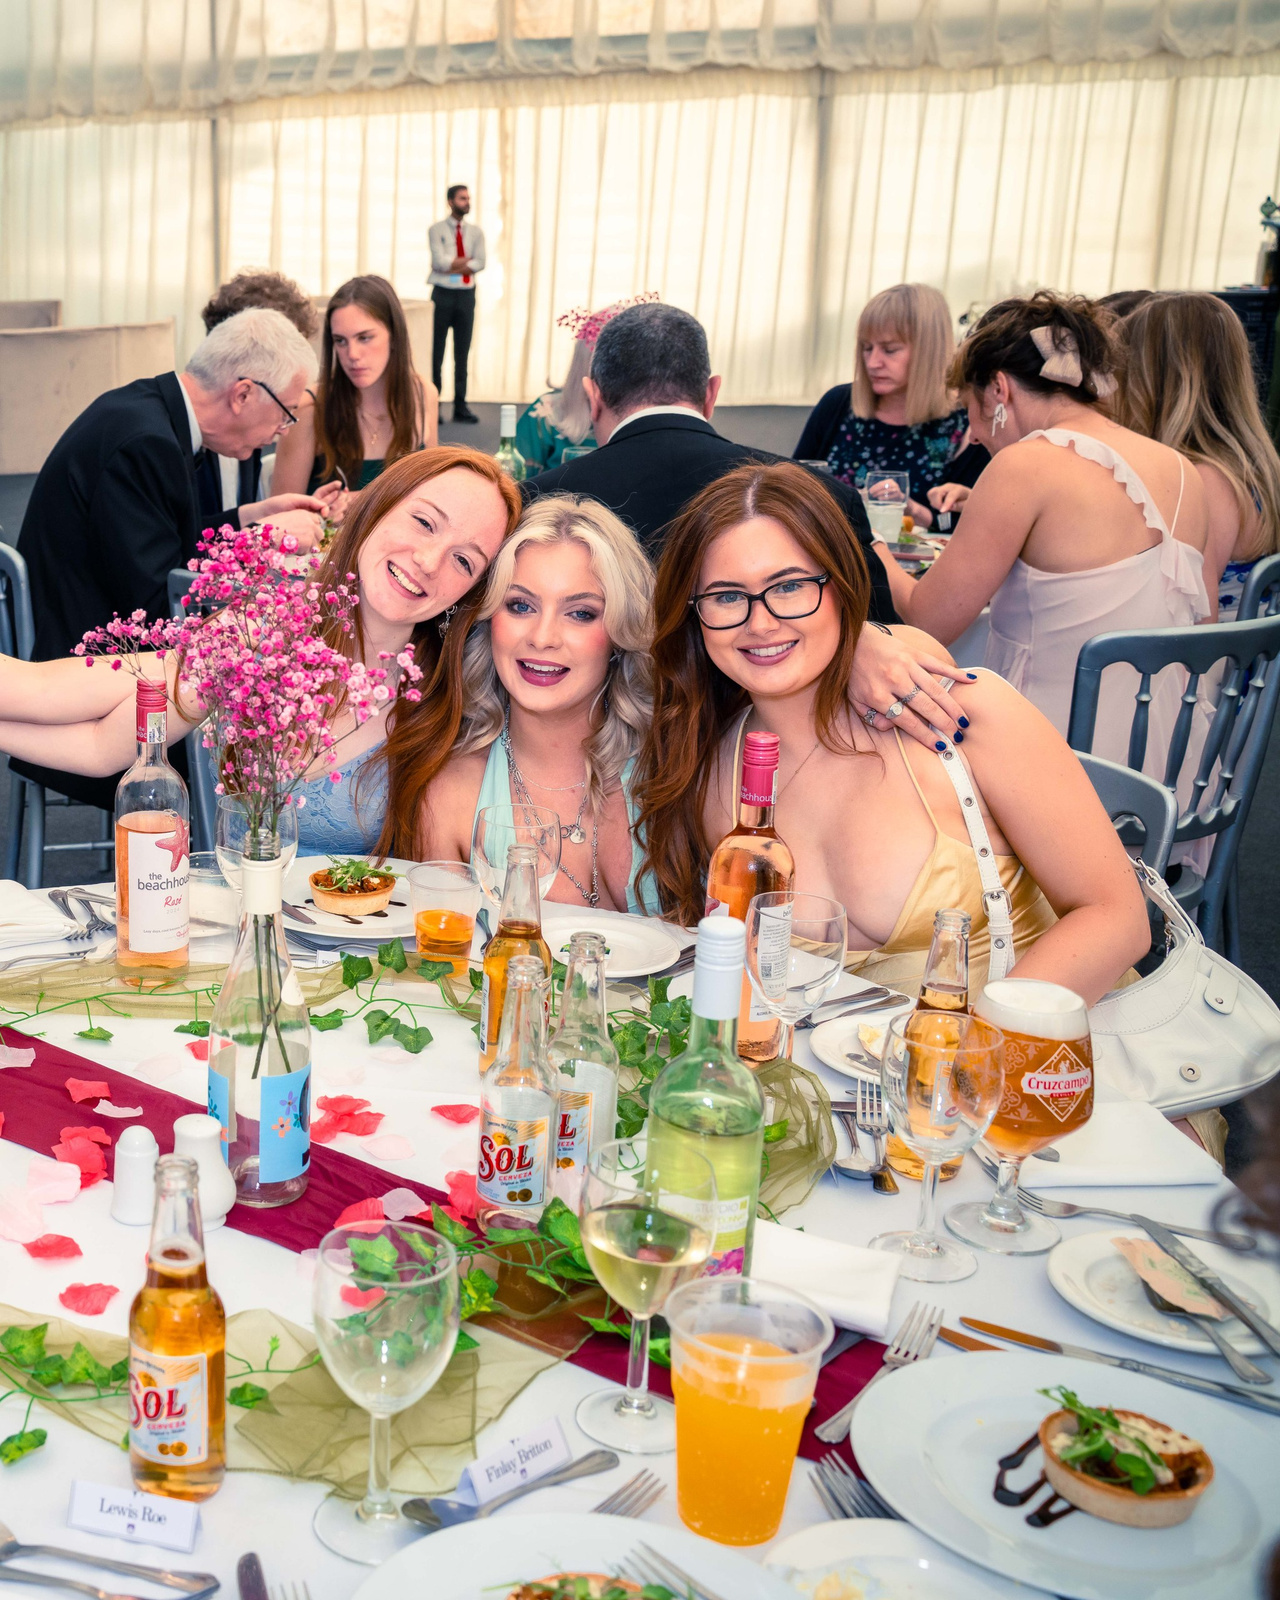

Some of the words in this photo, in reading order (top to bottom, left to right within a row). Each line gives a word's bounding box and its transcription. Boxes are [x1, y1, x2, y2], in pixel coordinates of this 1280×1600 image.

[137, 873, 190, 891] beachhou
[149, 872, 163, 880] the
[163, 894, 183, 907] Rosé
[1028, 1075, 1088, 1090] Cruzcampo
[479, 1135, 534, 1182] SOL
[499, 1171, 532, 1181] CERVEZA
[129, 1372, 186, 1430] SOL
[485, 1458, 517, 1482] Finlay
[517, 1439, 552, 1464] Britton
[99, 1498, 138, 1519] Lewis
[141, 1506, 166, 1525] Roe
